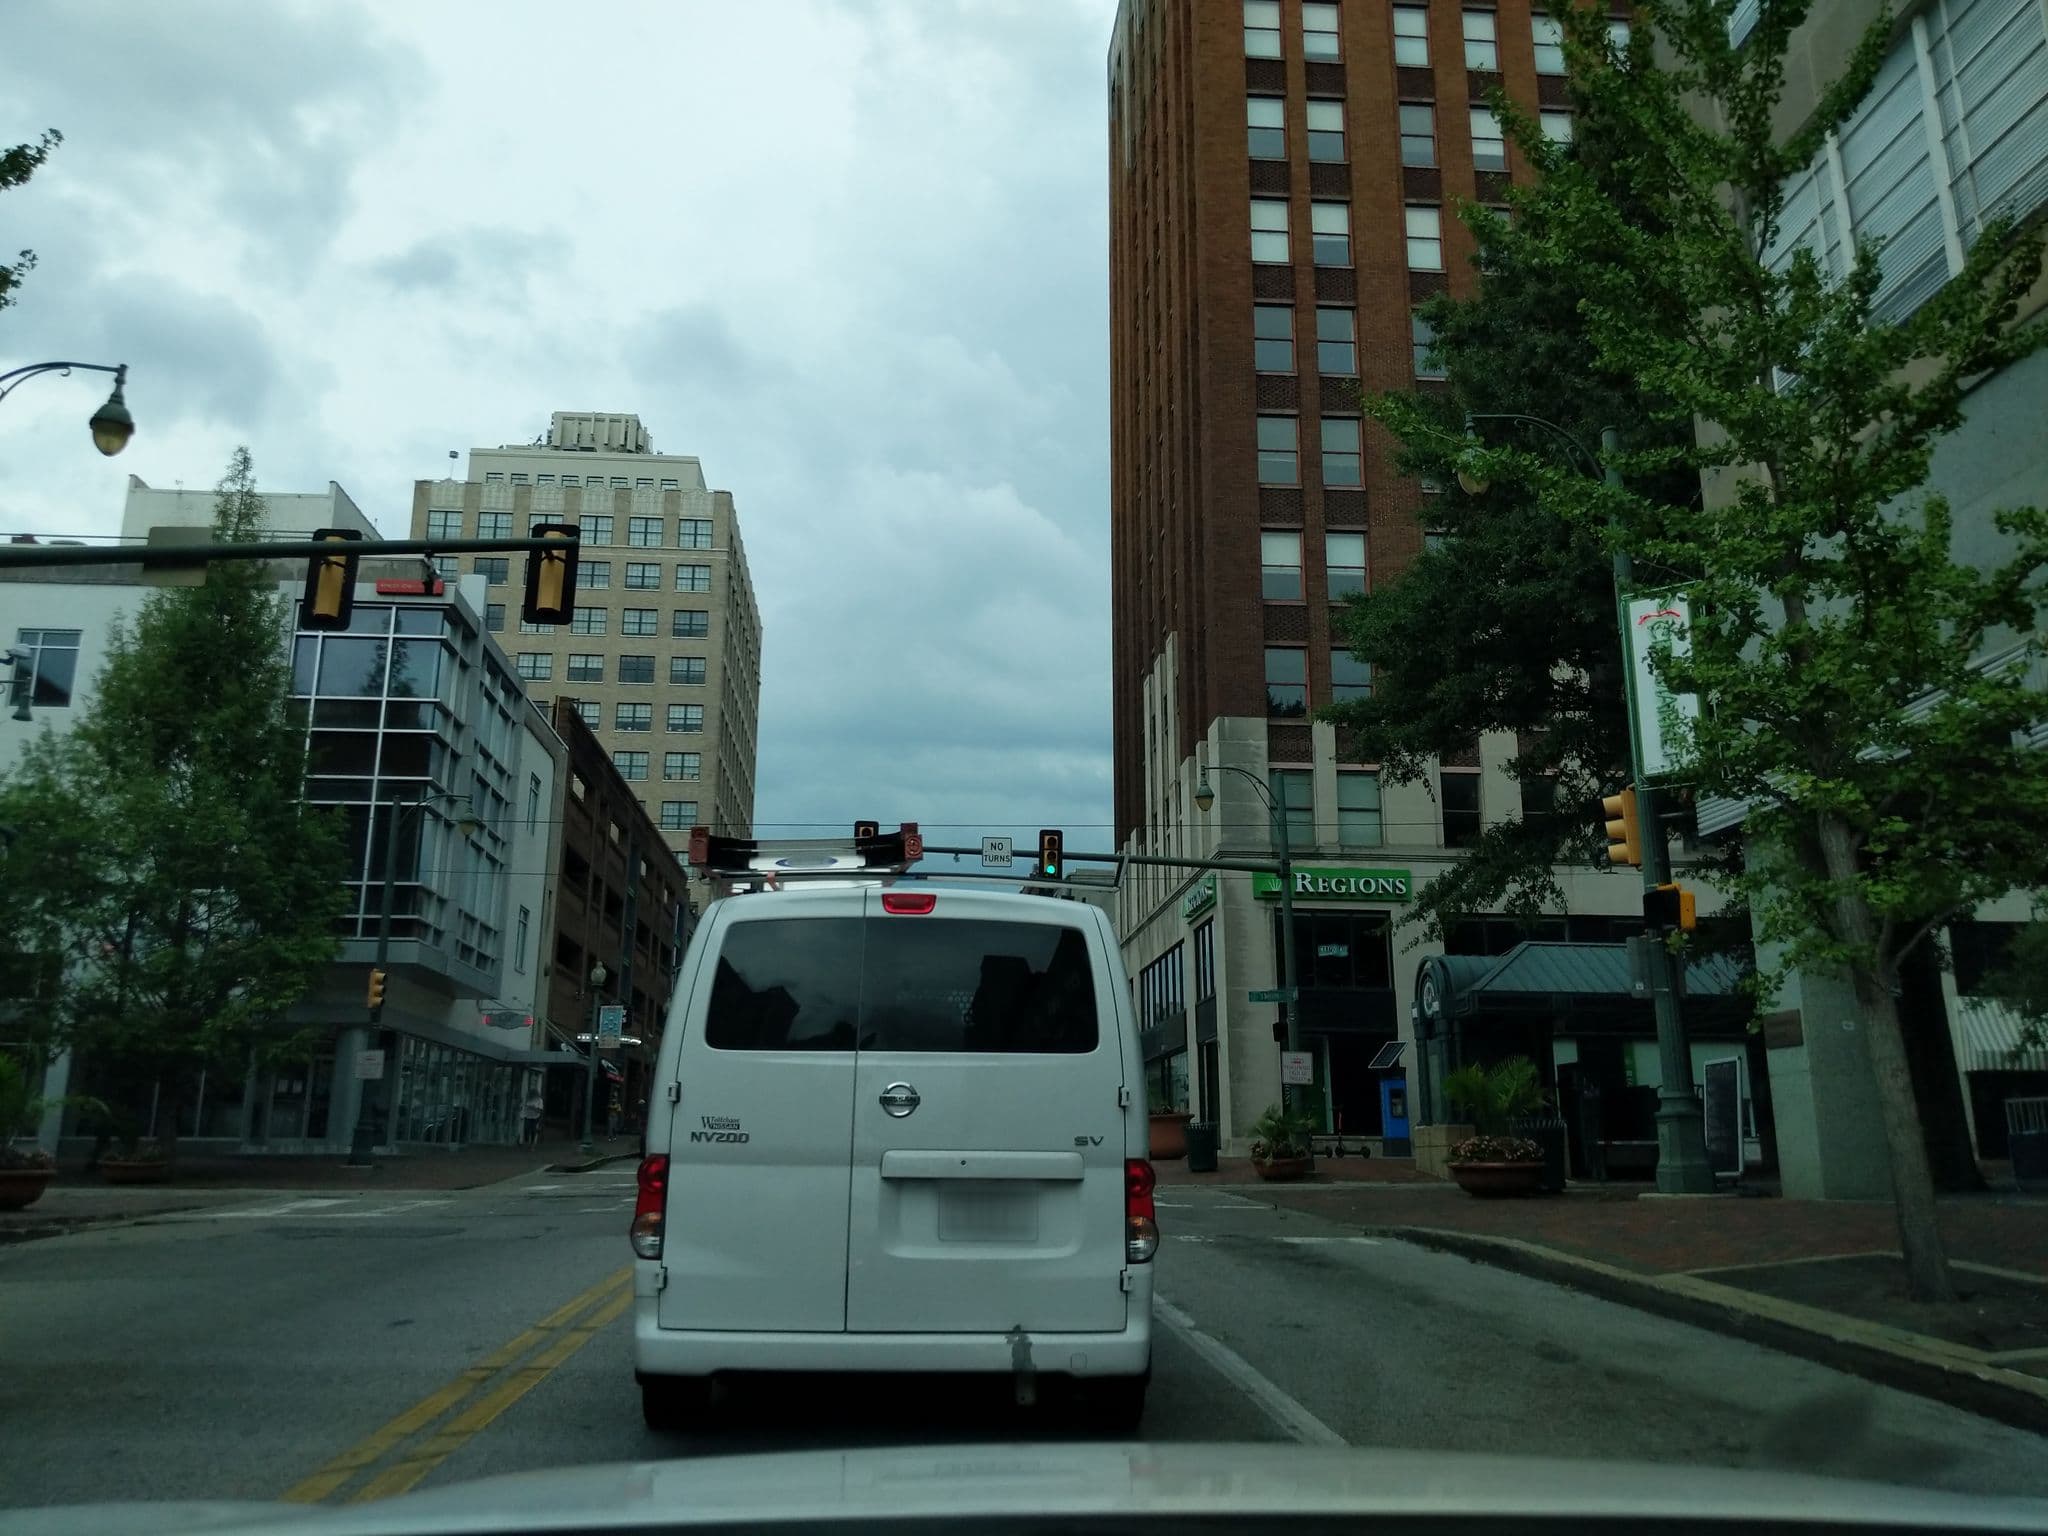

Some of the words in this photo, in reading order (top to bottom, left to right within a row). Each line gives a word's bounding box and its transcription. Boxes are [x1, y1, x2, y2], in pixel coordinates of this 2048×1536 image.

[990, 842, 1004, 851] NO
[984, 854, 1011, 863] TURNS
[1294, 872, 1407, 894] REGIONS
[690, 1131, 750, 1143] NV200
[1074, 1135, 1105, 1146] SV
